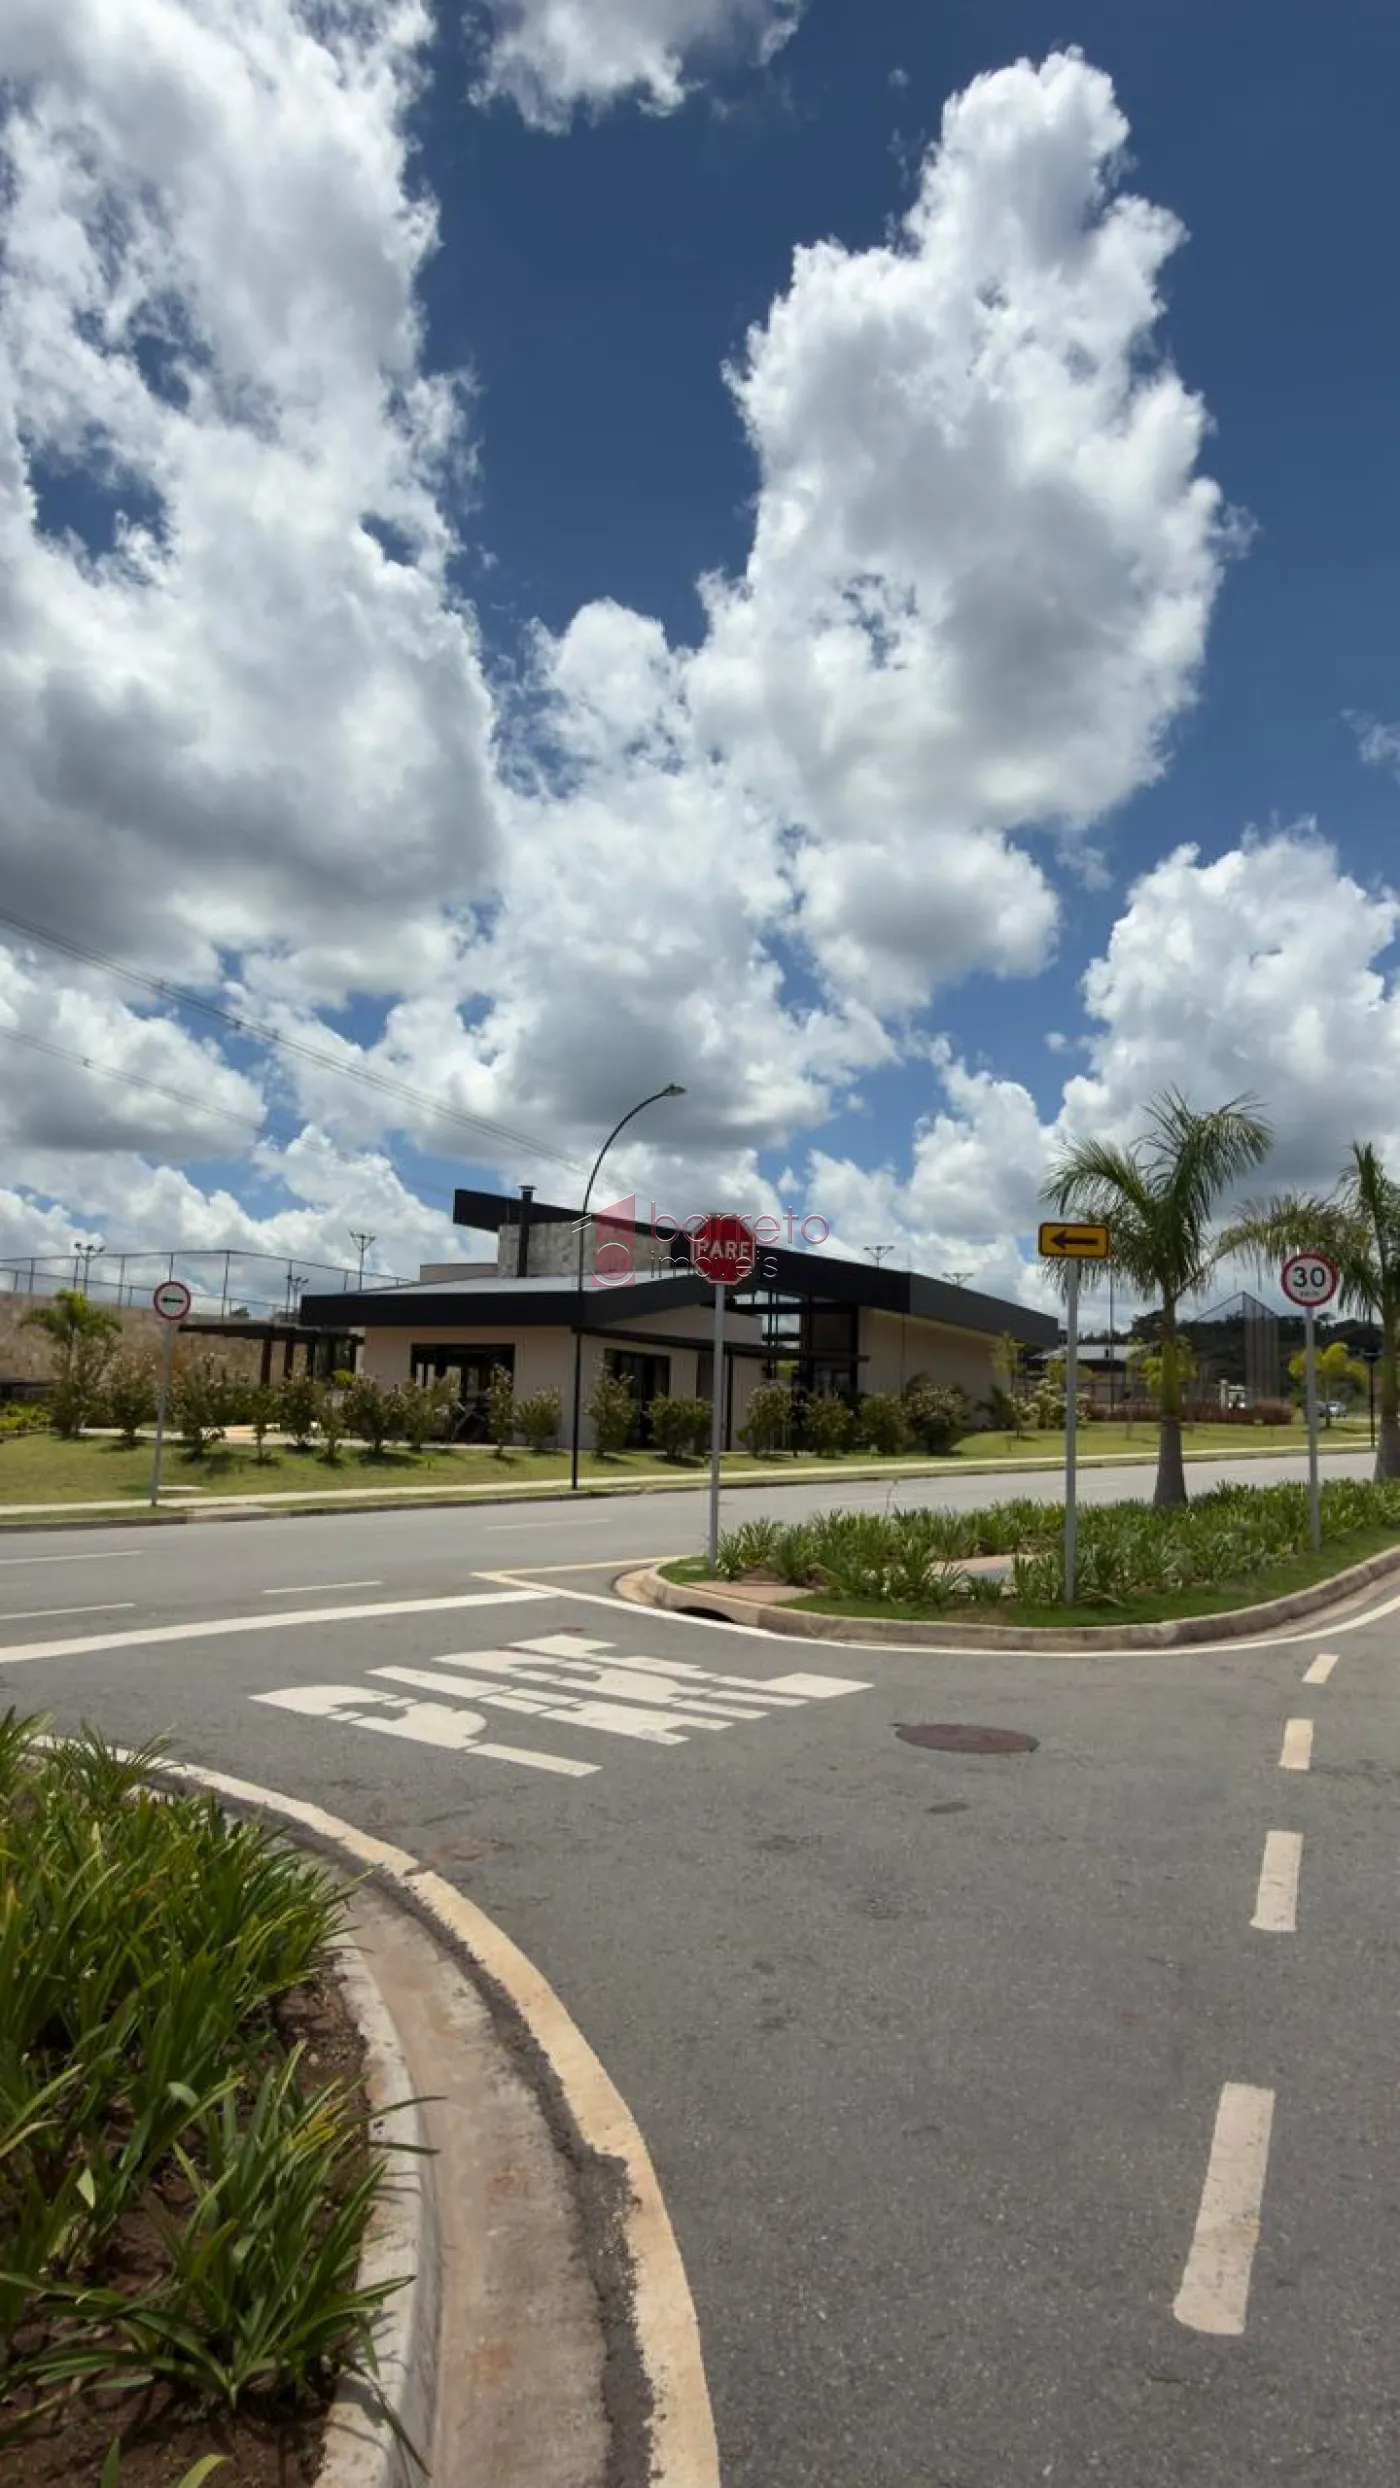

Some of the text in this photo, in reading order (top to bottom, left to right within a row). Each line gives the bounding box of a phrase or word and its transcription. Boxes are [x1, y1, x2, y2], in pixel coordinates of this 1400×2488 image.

[696, 1239, 752, 1258] PARE
[1292, 1266, 1326, 1288] 30
[248, 1633, 874, 1778] PARE
